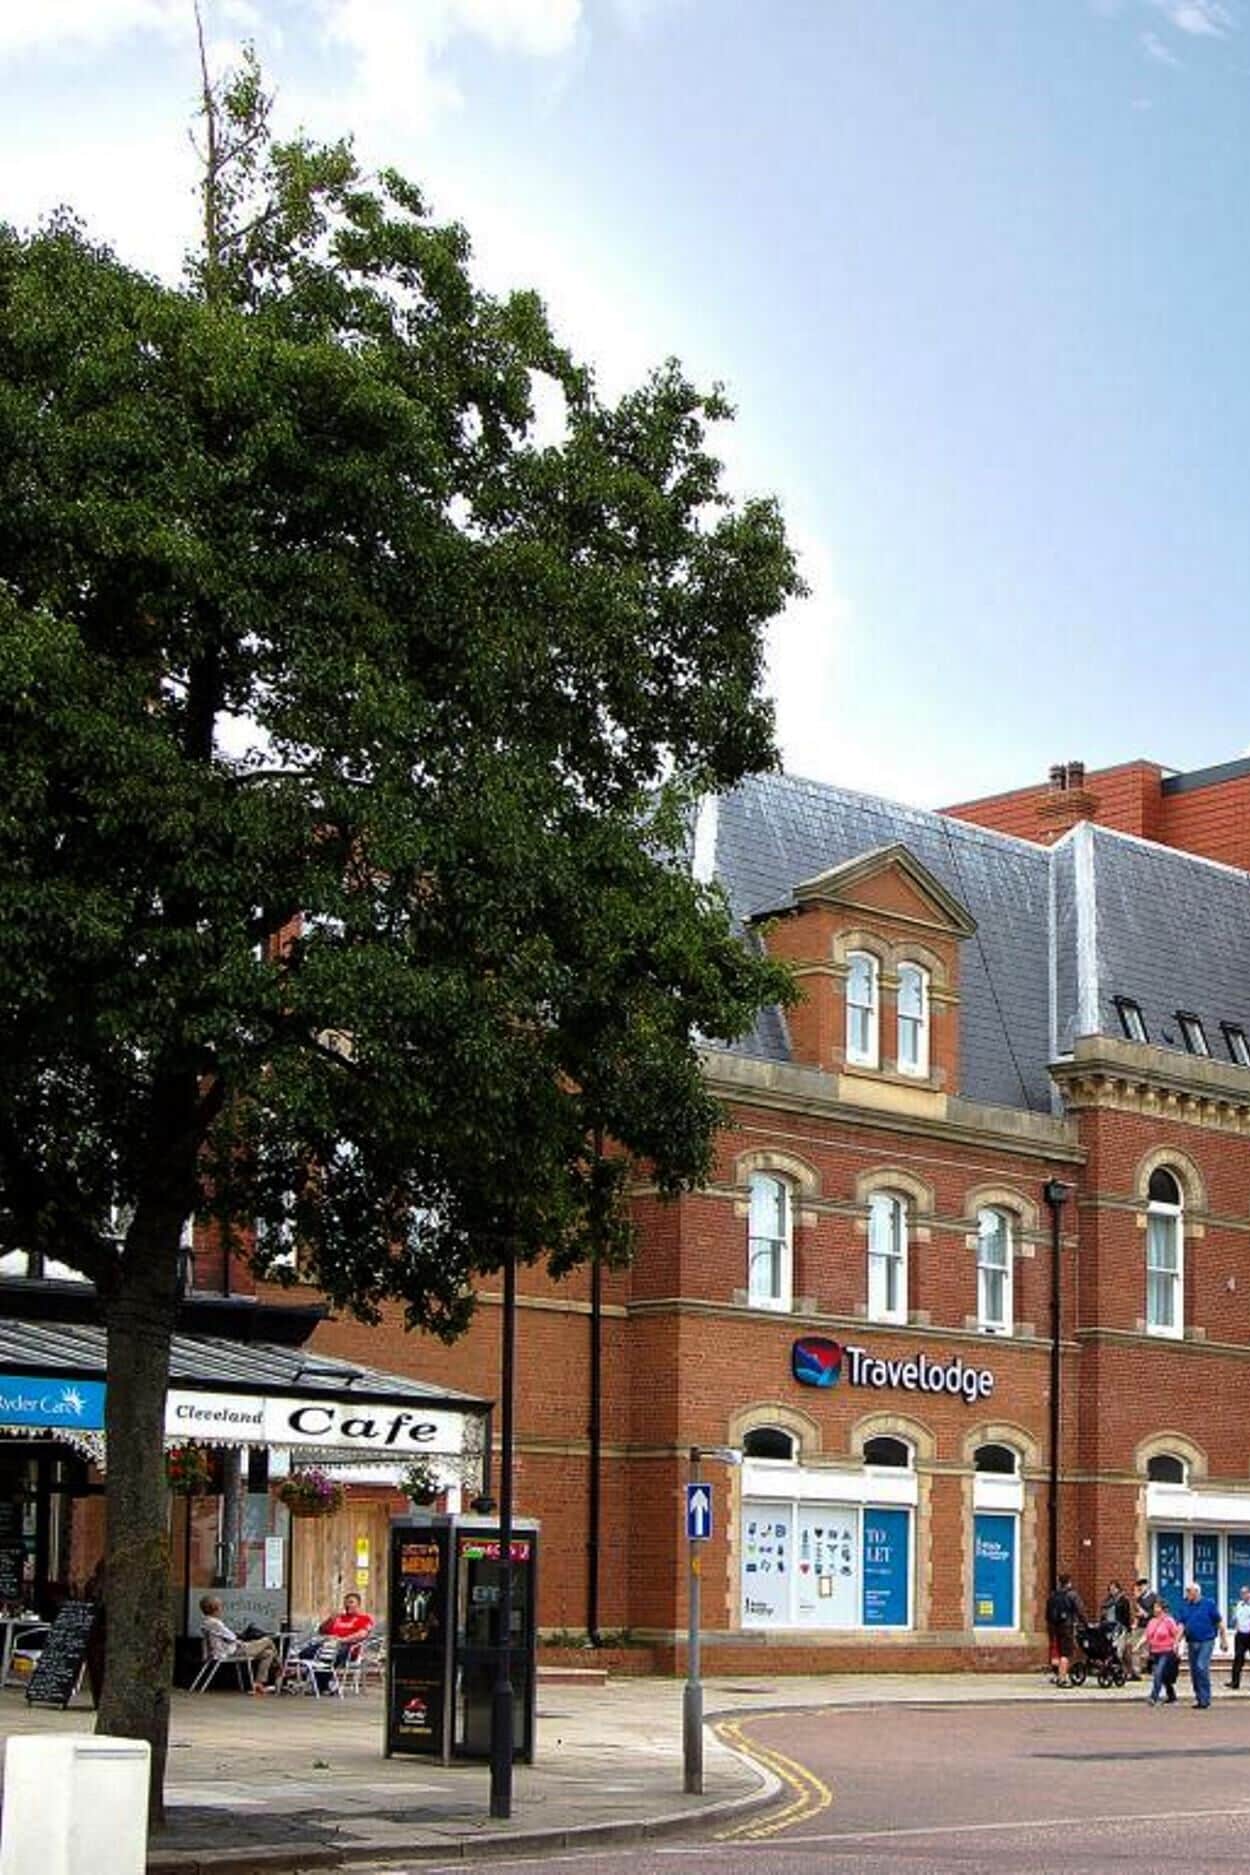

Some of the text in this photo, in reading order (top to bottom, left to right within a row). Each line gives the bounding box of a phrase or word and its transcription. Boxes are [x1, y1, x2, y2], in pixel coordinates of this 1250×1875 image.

[845, 1346, 994, 1402] Travelodge
[176, 1404, 437, 1445] Cleveland Cafe
[865, 1528, 887, 1544] TO
[865, 1546, 891, 1563] LET
